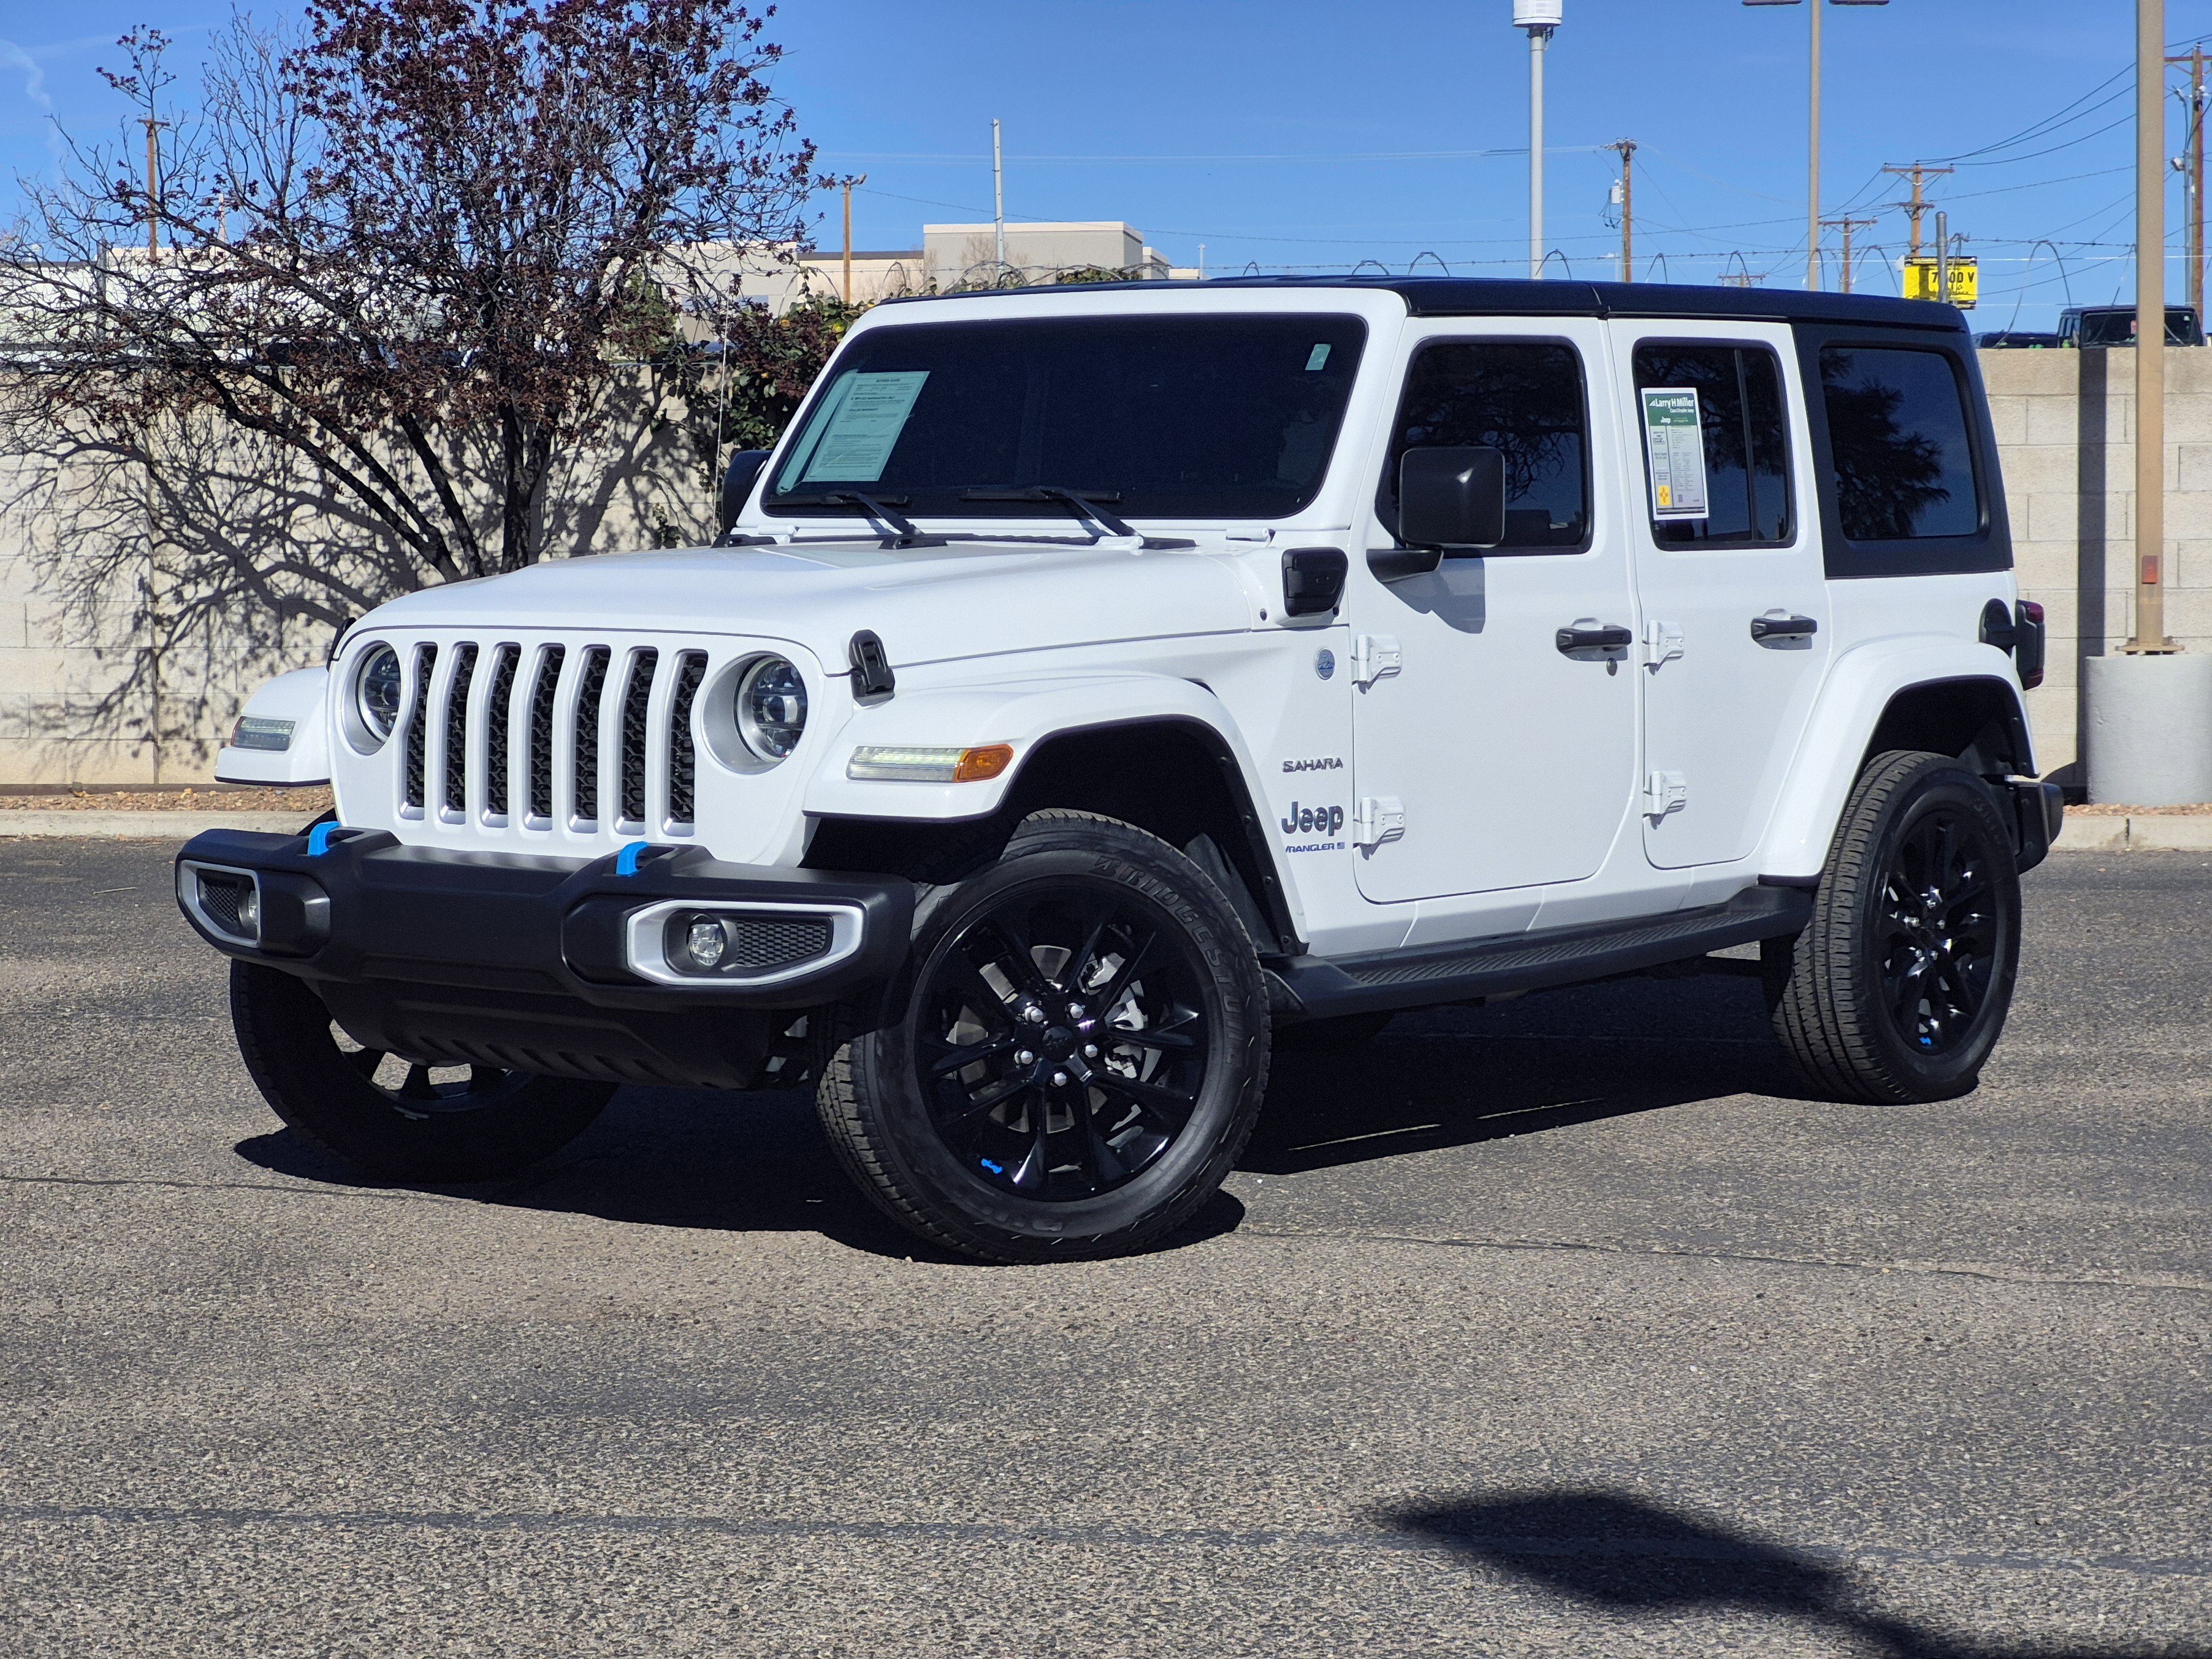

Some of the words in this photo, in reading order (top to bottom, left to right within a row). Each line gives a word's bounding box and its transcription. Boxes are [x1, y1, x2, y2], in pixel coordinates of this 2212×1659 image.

[1932, 272, 1964, 283] 700
[1968, 272, 1975, 283] V
[1655, 398, 1671, 409] Larry
[1677, 397, 1694, 407] Miller
[1282, 757, 1343, 773] SAHARA
[1281, 801, 1344, 837] Jeep
